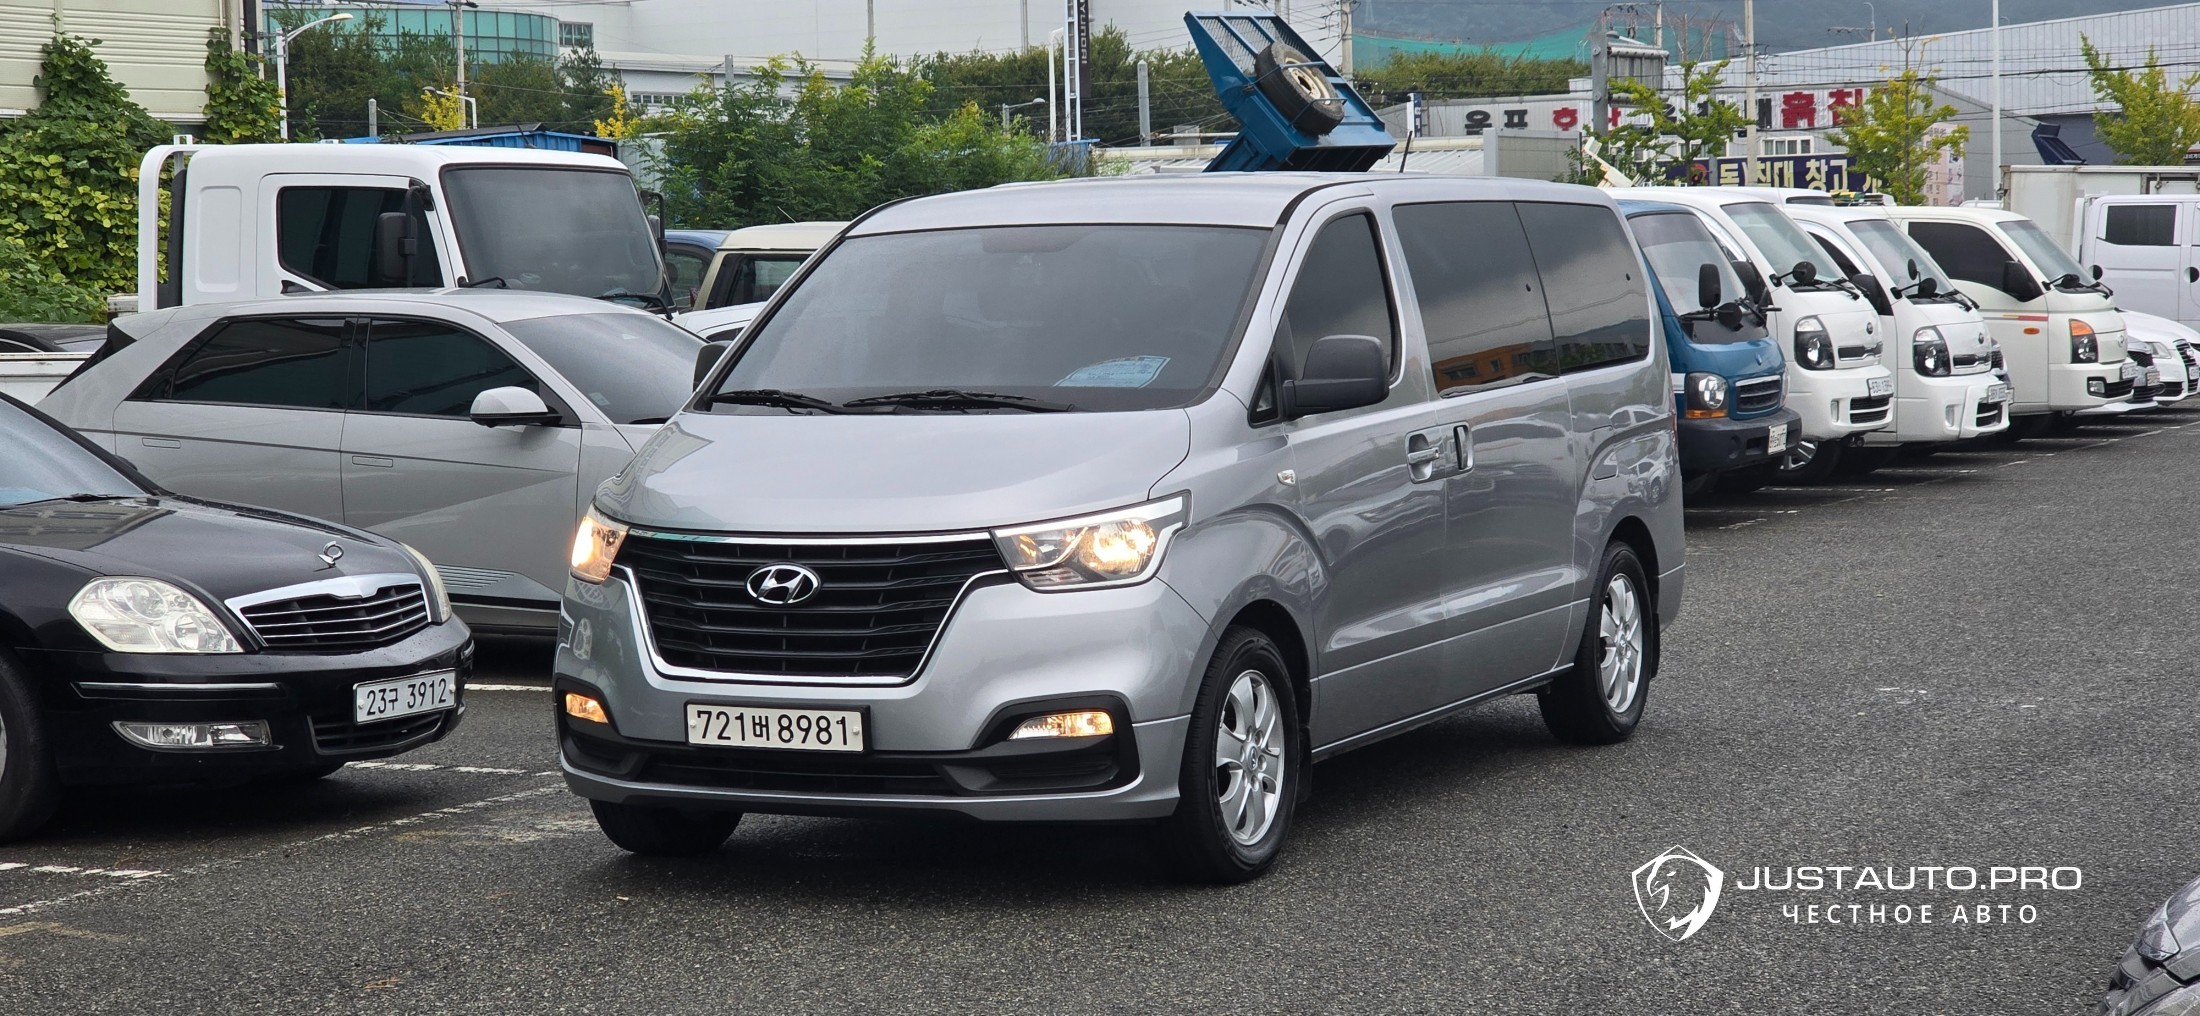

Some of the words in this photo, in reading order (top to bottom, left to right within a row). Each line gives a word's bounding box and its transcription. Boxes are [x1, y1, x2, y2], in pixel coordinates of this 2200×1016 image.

[1805, 158, 1850, 193] 창고
[366, 688, 398, 716] 23구
[407, 678, 447, 709] 3912
